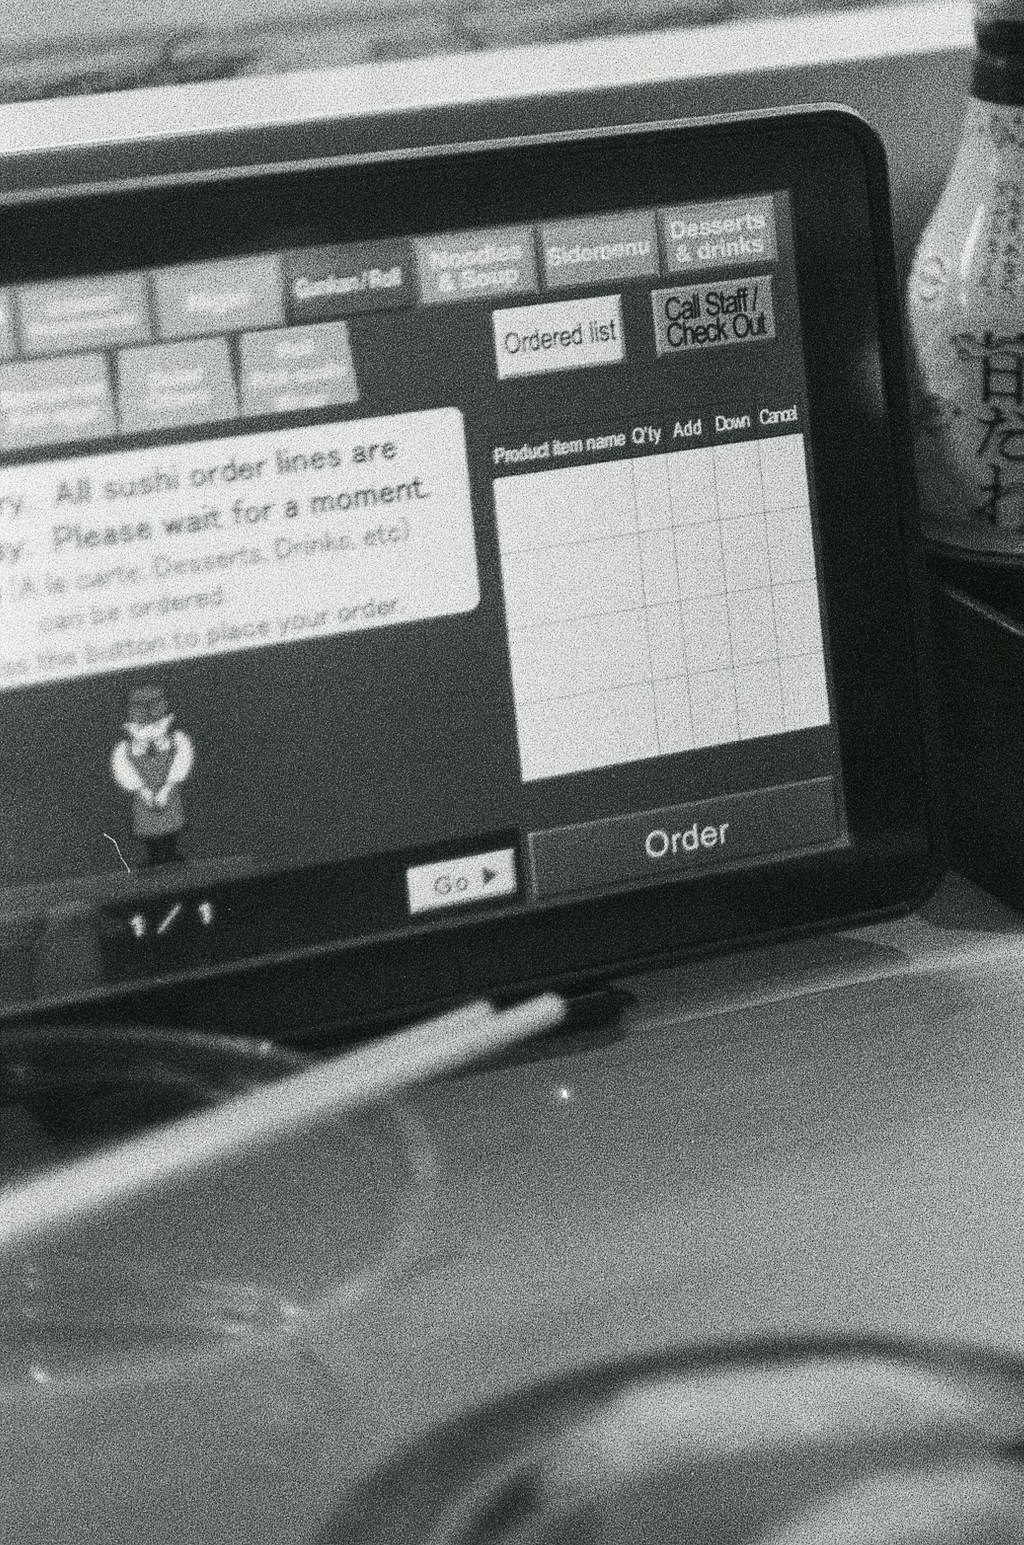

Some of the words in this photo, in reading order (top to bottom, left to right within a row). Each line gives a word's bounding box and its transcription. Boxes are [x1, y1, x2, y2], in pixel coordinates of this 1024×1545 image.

[670, 210, 768, 240] Desserts
[675, 244, 693, 264] &
[697, 235, 766, 262] drinks
[664, 294, 702, 321] Call
[705, 288, 749, 316] Staff
[503, 322, 583, 355] Ordered
[589, 318, 618, 344] list
[666, 317, 728, 348] Check
[732, 312, 768, 338] Out
[493, 442, 549, 464] Product
[552, 438, 583, 459] item
[585, 432, 626, 453] name
[630, 424, 663, 447] Q'ty
[672, 418, 702, 439] Add
[714, 413, 751, 434] Down
[758, 404, 799, 426] Cancel
[55, 477, 92, 506] All
[103, 465, 181, 502] sushi
[189, 452, 268, 488] order
[274, 447, 343, 476] lines
[351, 439, 399, 466] are
[52, 522, 154, 553] Please
[162, 505, 223, 537] wait
[231, 497, 275, 525] for
[283, 499, 300, 520] a
[129, 584, 225, 618] ordered
[172, 628, 201, 650] to
[205, 617, 272, 647] place
[278, 610, 329, 639] your
[643, 818, 732, 860] Order
[432, 872, 471, 898] Go
